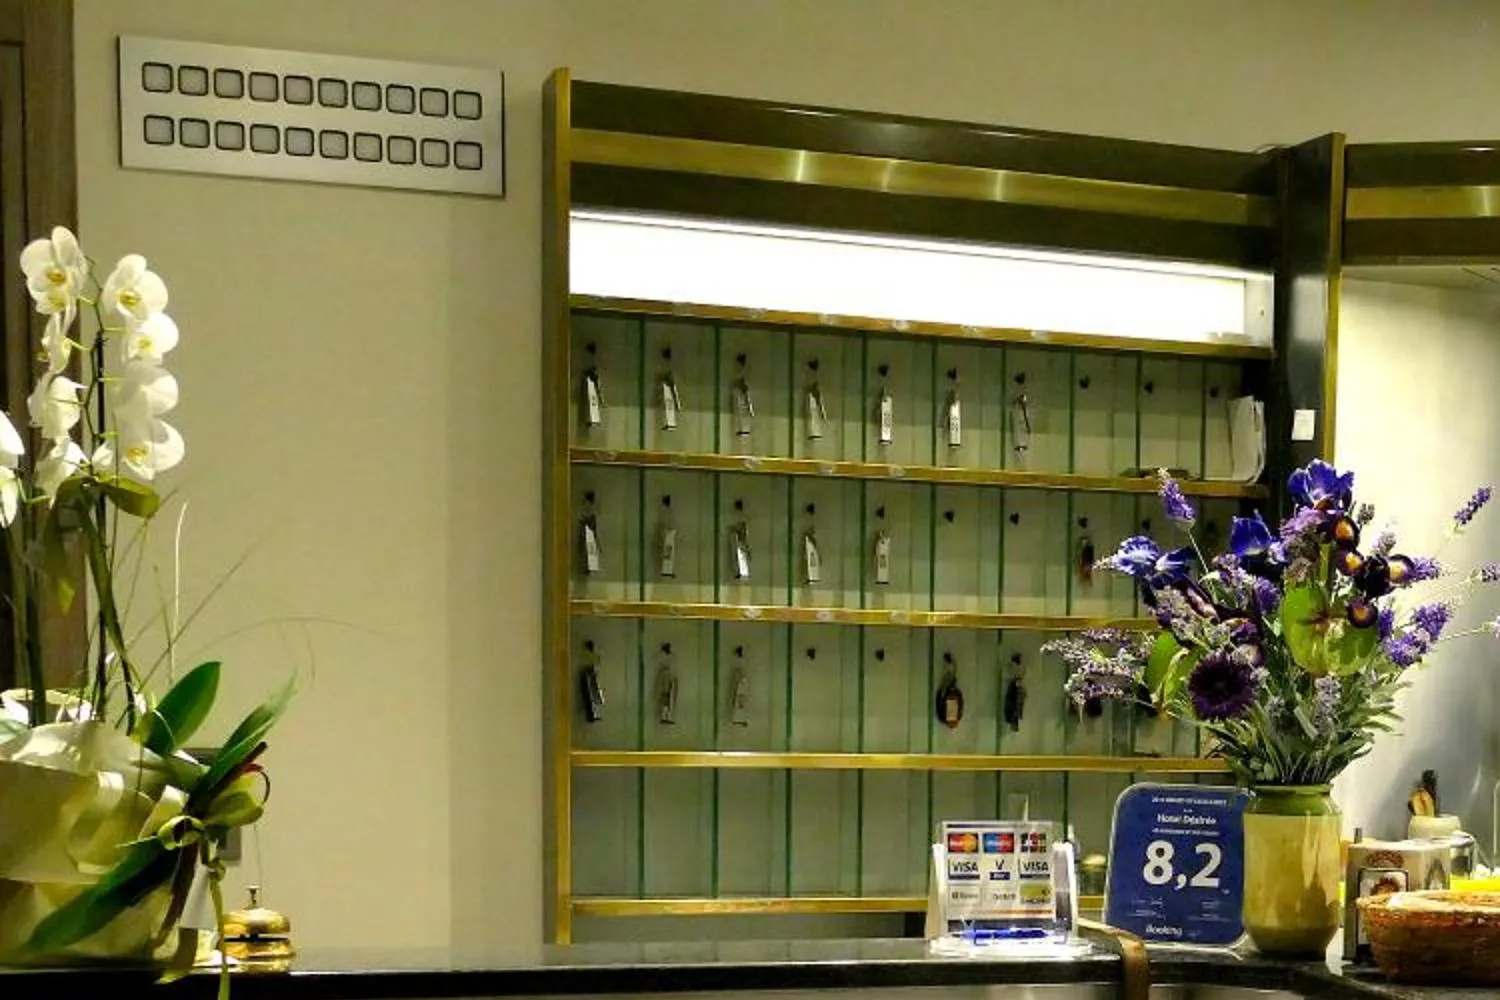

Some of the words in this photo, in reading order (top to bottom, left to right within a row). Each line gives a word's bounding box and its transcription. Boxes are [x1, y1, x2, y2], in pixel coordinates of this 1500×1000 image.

[952, 861, 978, 872] VISA
[1023, 861, 1049, 871] VISA
[1143, 840, 1222, 890] 8,2
